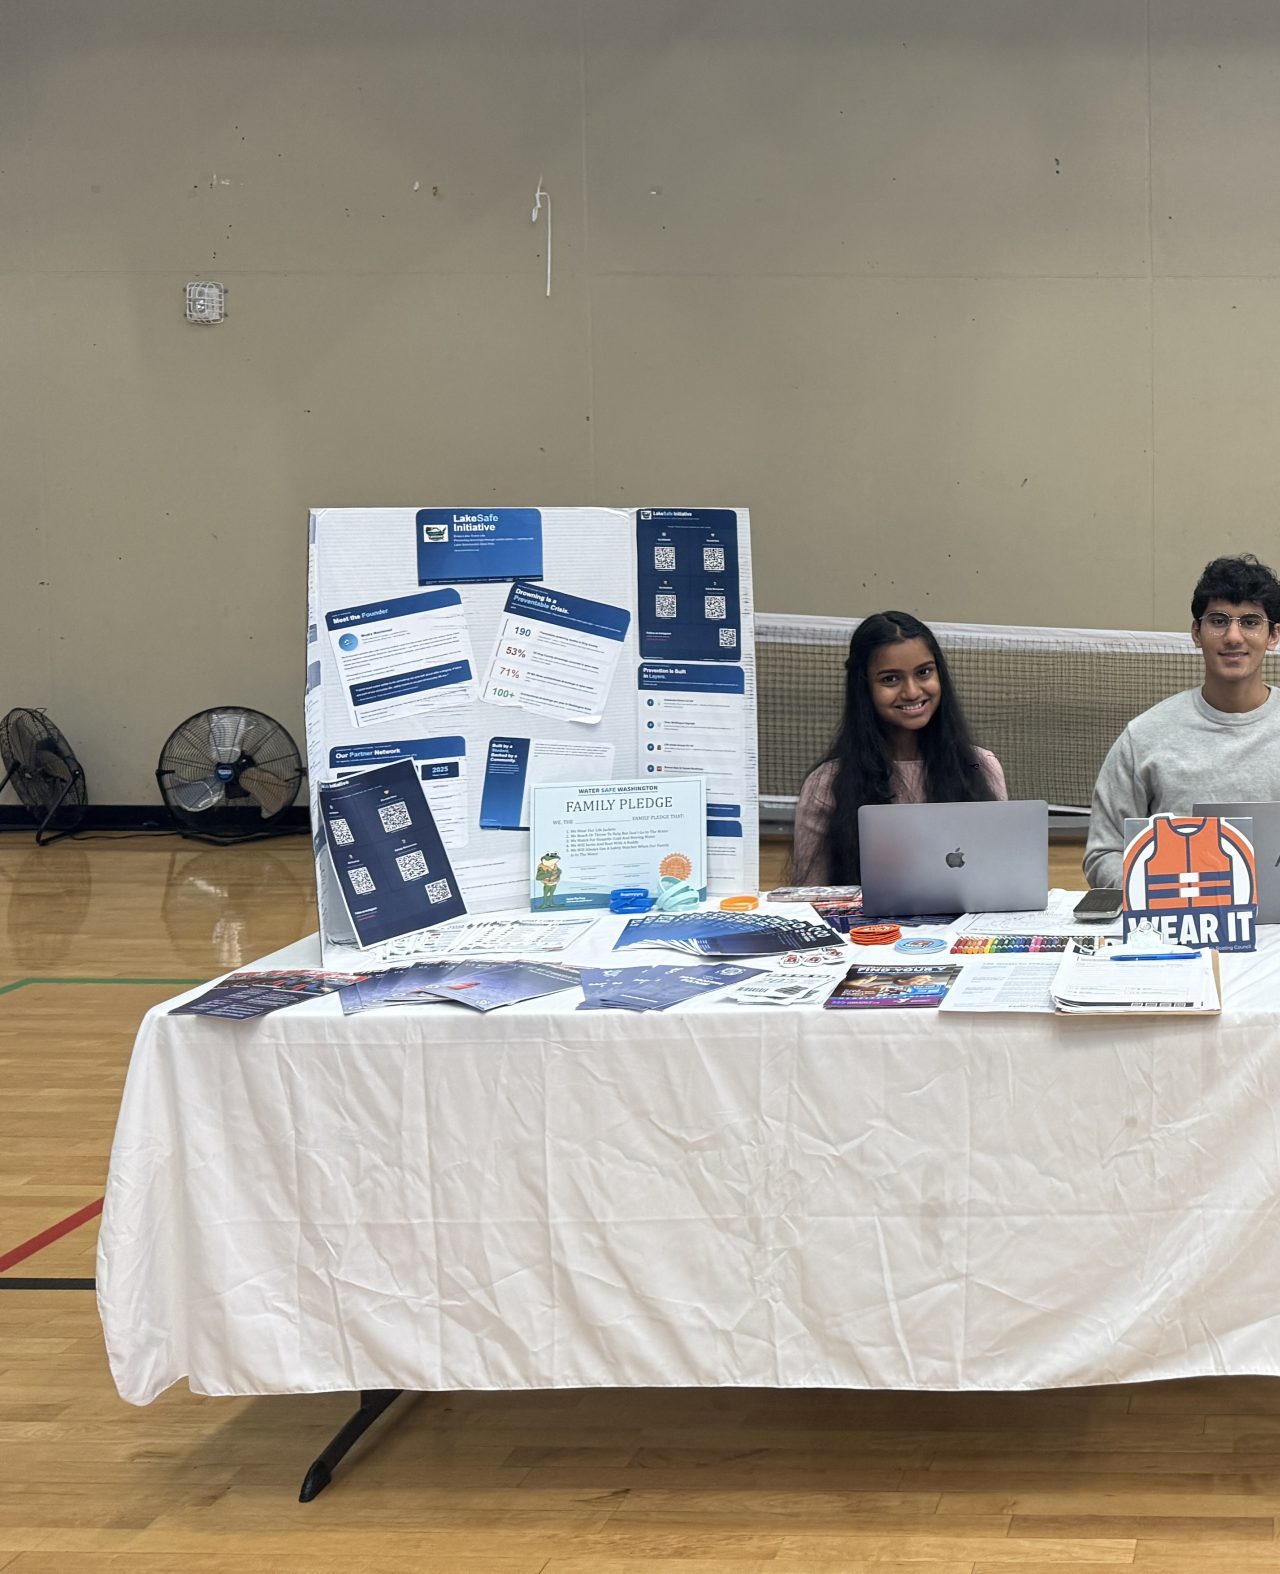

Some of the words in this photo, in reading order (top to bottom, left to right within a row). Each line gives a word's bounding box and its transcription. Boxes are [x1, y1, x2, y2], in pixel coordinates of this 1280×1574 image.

[453, 514, 499, 523] LakeSafe
[453, 524, 496, 532] Initiative
[516, 588, 545, 603] Drowning
[362, 609, 389, 619] Founder
[514, 627, 531, 637] 190
[506, 646, 526, 659] 53%
[500, 667, 520, 679] 71%
[493, 688, 515, 699] 100+
[432, 766, 449, 774] 2025
[566, 800, 616, 813] FAMILY
[620, 797, 673, 810] PLEDGE
[1227, 912, 1253, 942] IT
